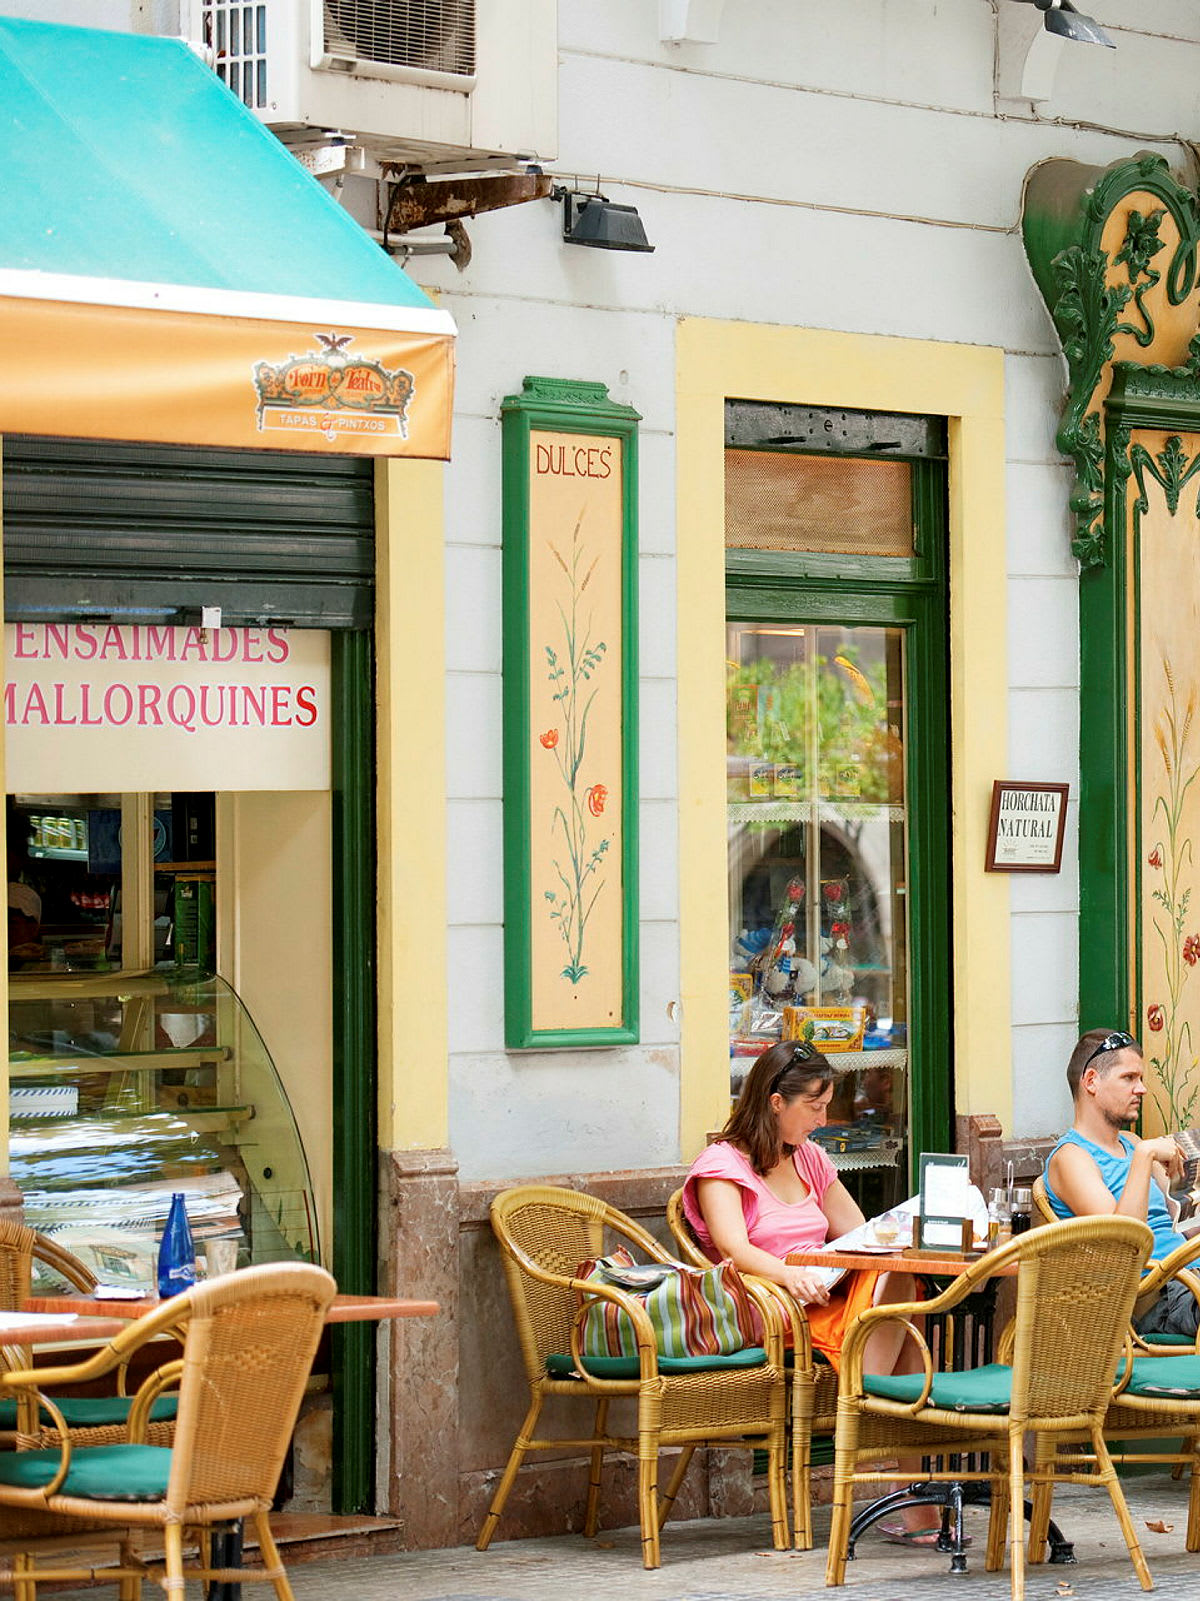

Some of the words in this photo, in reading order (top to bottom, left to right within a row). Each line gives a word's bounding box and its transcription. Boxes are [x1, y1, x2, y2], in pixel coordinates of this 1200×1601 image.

[289, 366, 327, 389] Forn
[280, 413, 318, 427] TAPAS
[338, 418, 386, 431] PINTXOS
[536, 444, 612, 479] DULCES
[14, 623, 290, 664] ENSAIMADES
[1002, 791, 1055, 812] HORCHATA
[999, 818, 1052, 838] NATURAL
